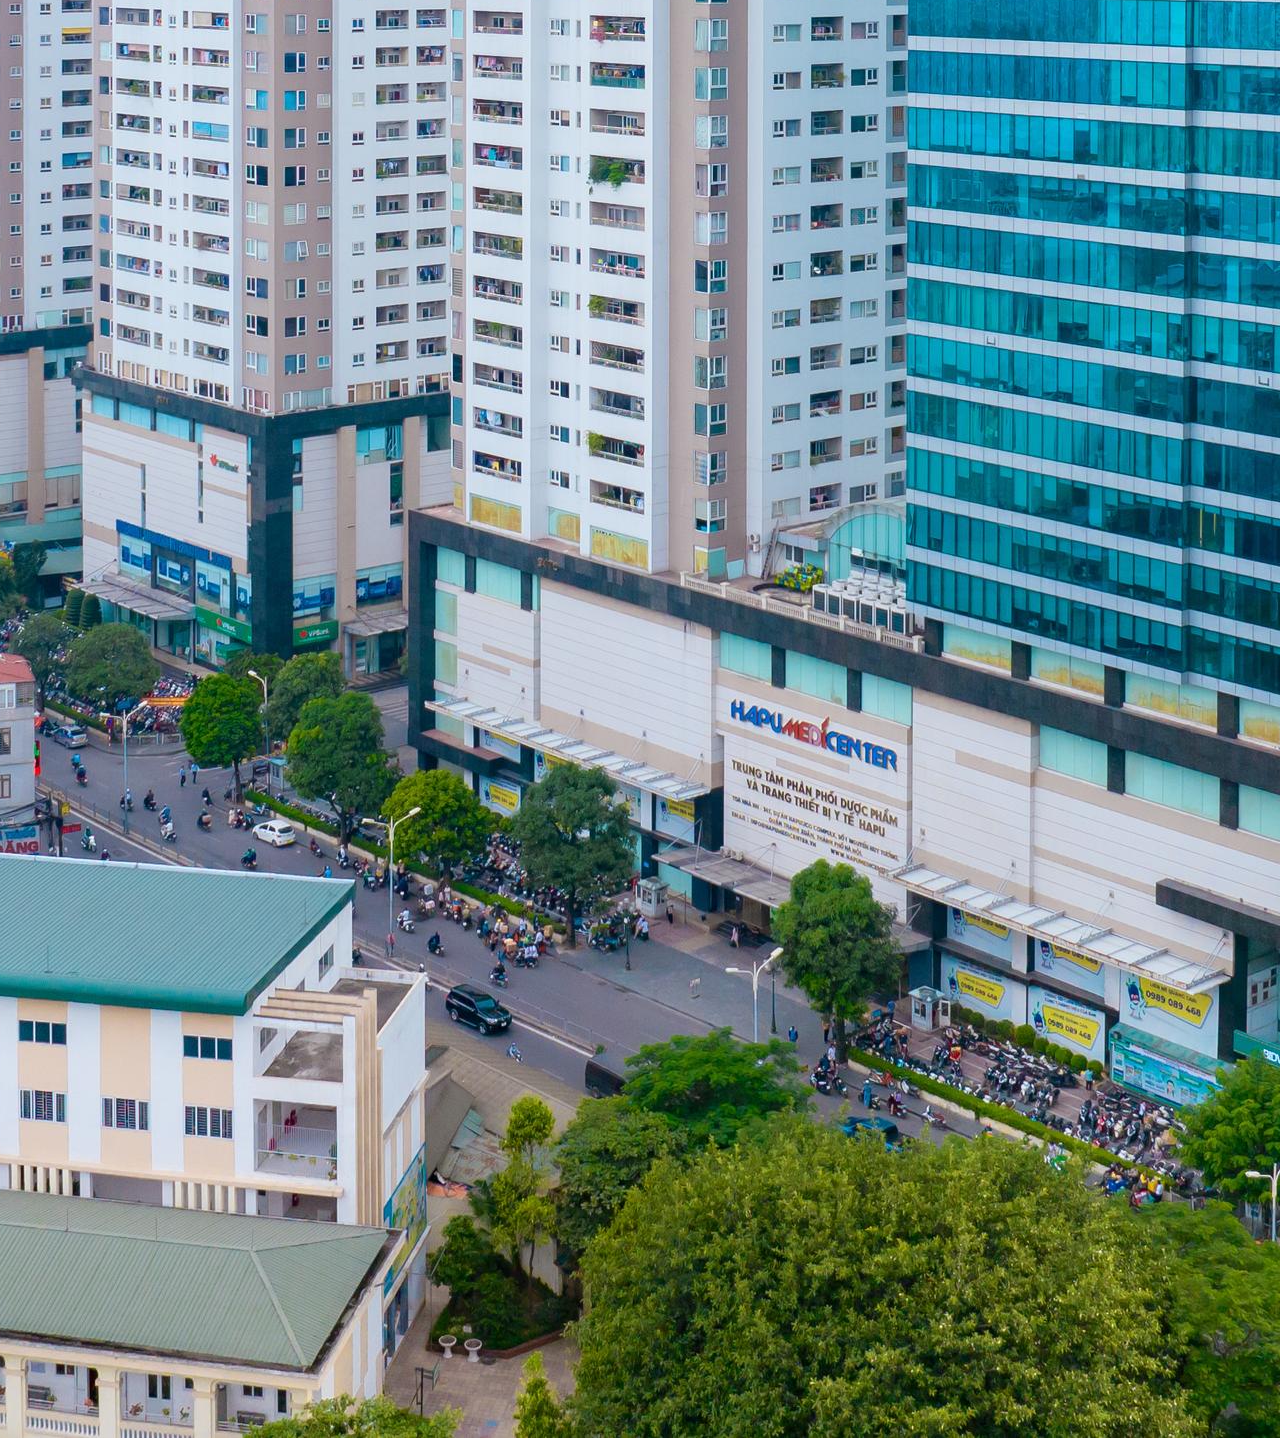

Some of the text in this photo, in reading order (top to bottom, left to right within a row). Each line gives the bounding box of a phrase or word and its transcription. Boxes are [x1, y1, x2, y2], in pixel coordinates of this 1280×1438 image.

[732, 759, 762, 780] TRUNG
[765, 767, 783, 787] TÂM
[747, 778, 759, 792] VÀ
[761, 783, 792, 804] TRANG
[834, 810, 842, 821] Y
[859, 819, 885, 837] HAPU
[1145, 990, 1201, 1017] 0989 089 468
